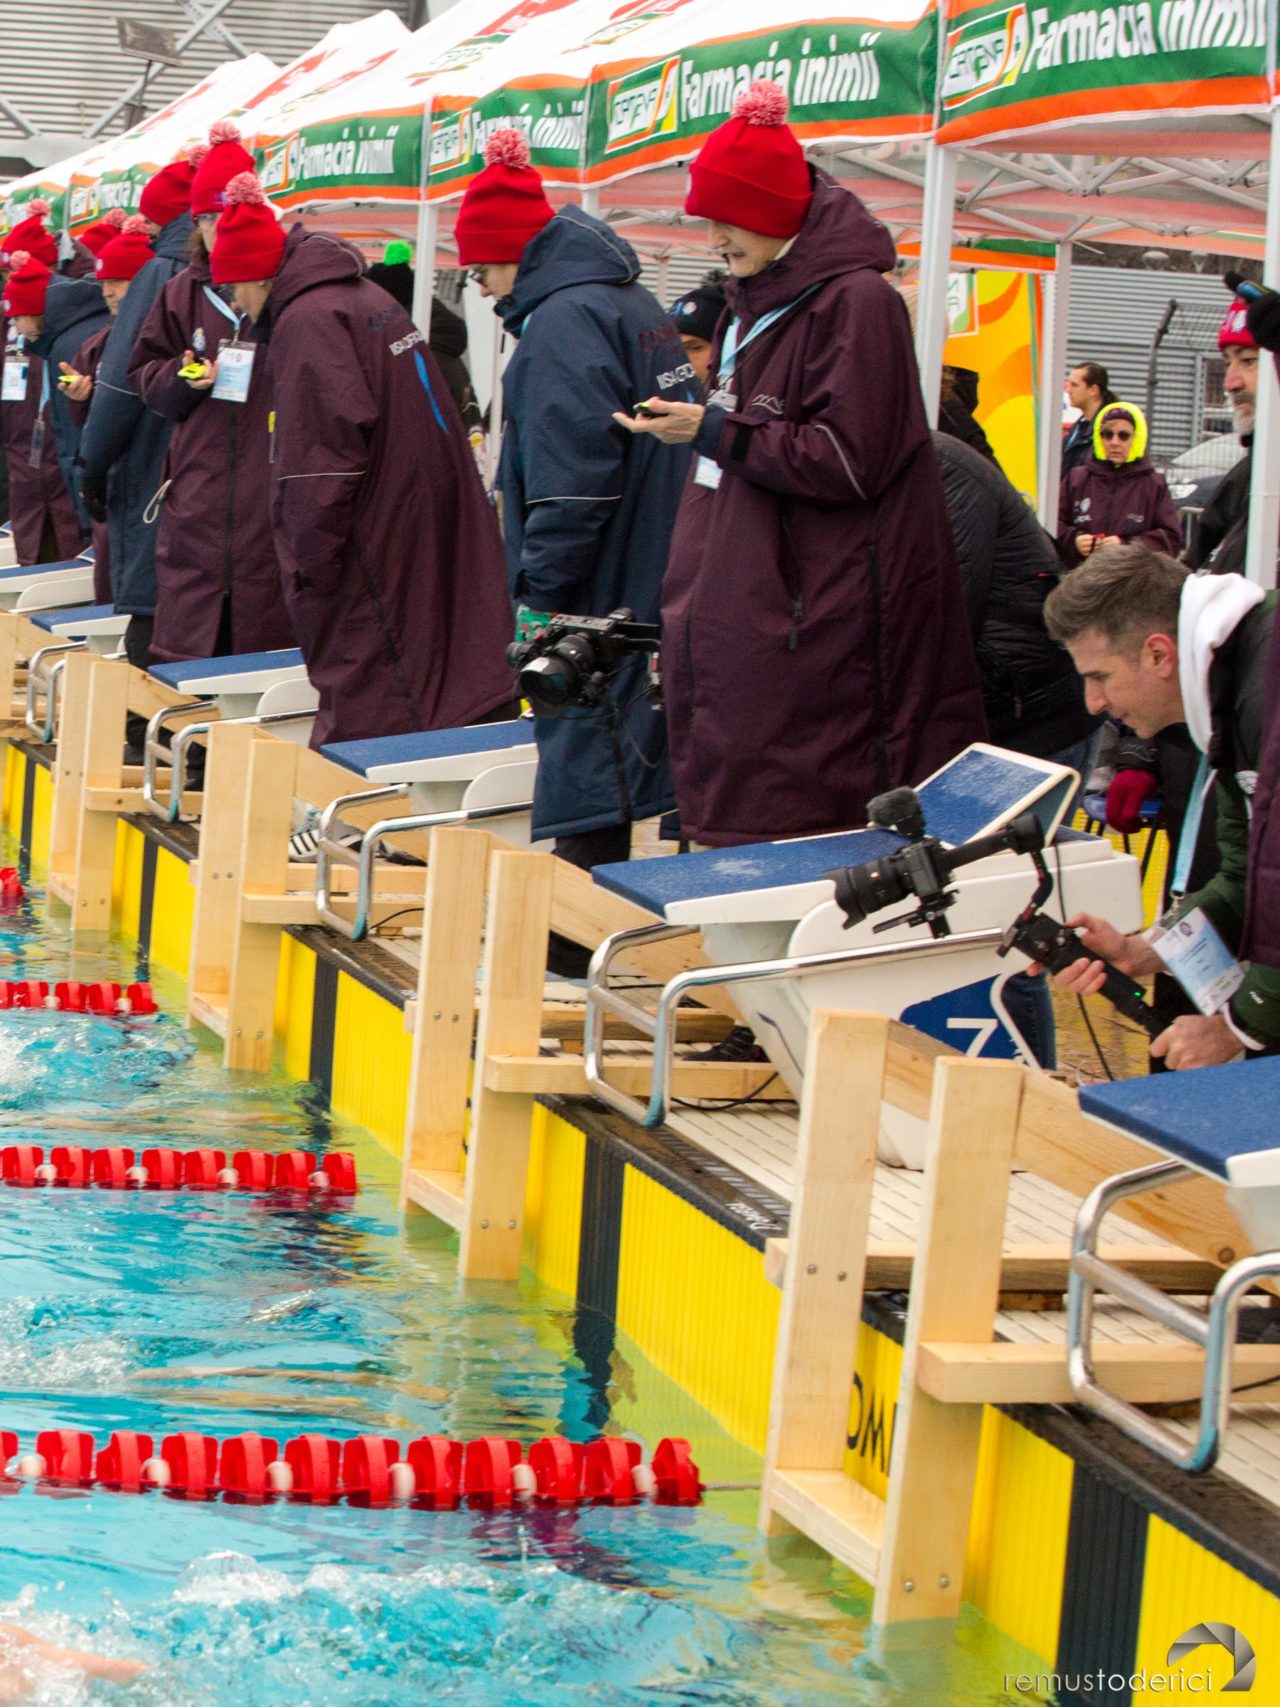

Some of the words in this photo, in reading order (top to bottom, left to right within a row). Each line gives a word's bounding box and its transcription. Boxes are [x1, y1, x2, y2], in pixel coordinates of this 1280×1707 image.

[793, 31, 882, 106] inimii
[1021, 2, 1158, 74] Farmacia
[946, 1017, 999, 1057] 7
